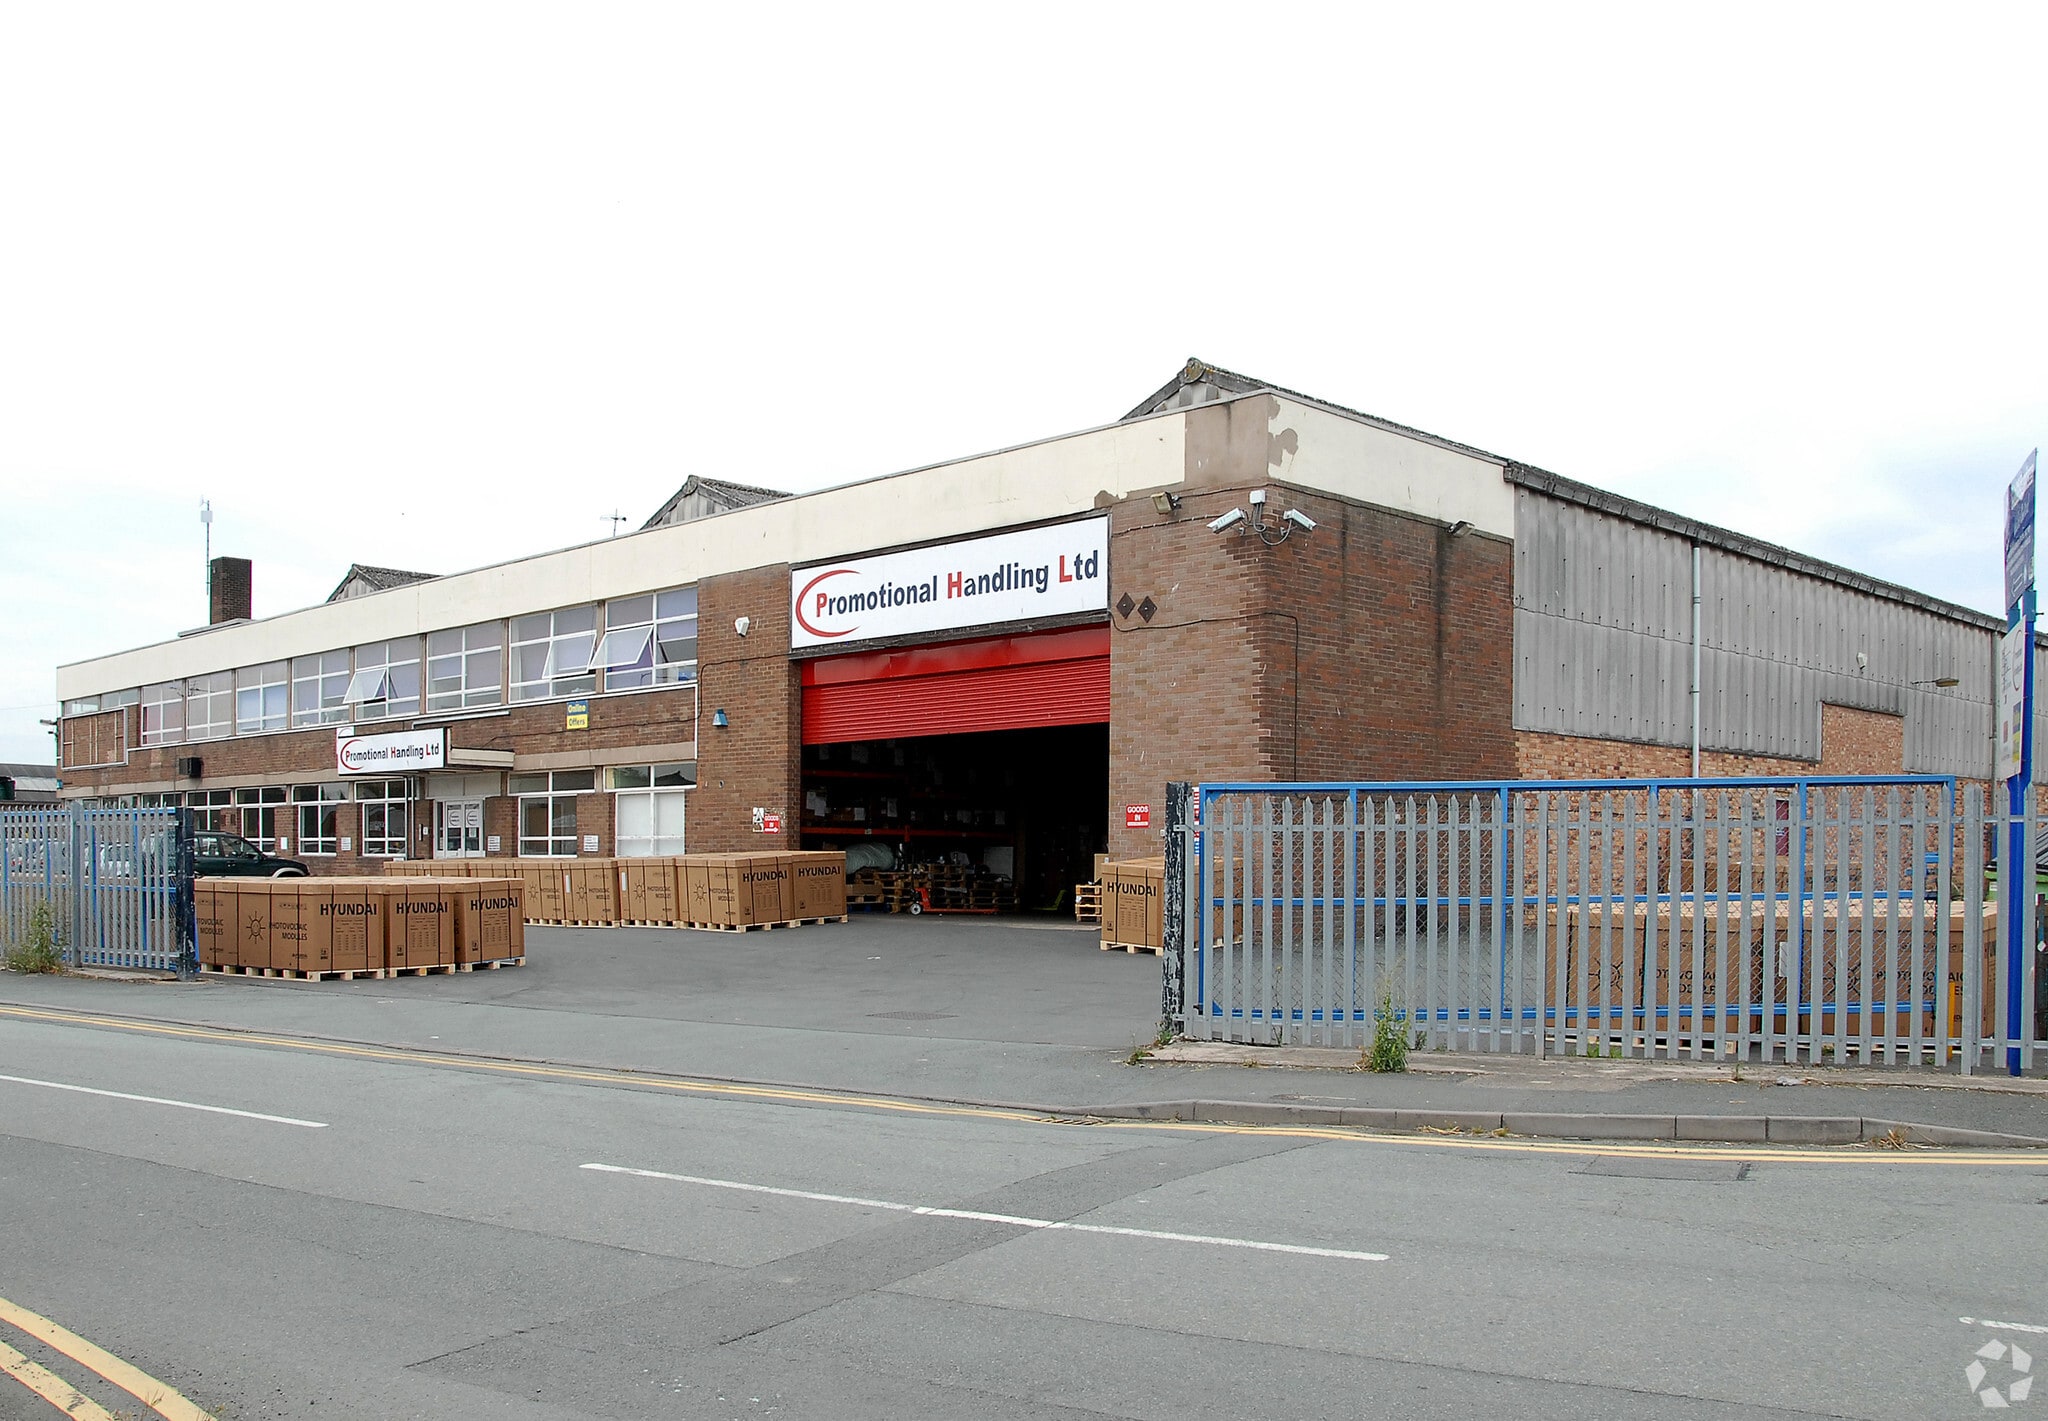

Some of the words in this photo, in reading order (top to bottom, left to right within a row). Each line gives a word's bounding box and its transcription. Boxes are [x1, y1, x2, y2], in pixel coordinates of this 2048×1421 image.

[816, 575, 938, 618] Promotional
[947, 562, 1049, 599] Handling
[1058, 550, 1099, 583] Ltd
[568, 704, 586, 713] Online
[345, 747, 388, 762] Promotional
[391, 745, 424, 760] Handling
[426, 743, 439, 756] Ltd
[1127, 806, 1149, 814] GOODS
[742, 870, 788, 882] HYUNDAI
[798, 866, 841, 877] HYUNDAI
[1107, 881, 1156, 897] HYUNDAI
[320, 903, 377, 916] HYUNDAI
[396, 901, 448, 915] HYUNDAI
[470, 896, 518, 911] HYUNDAI
